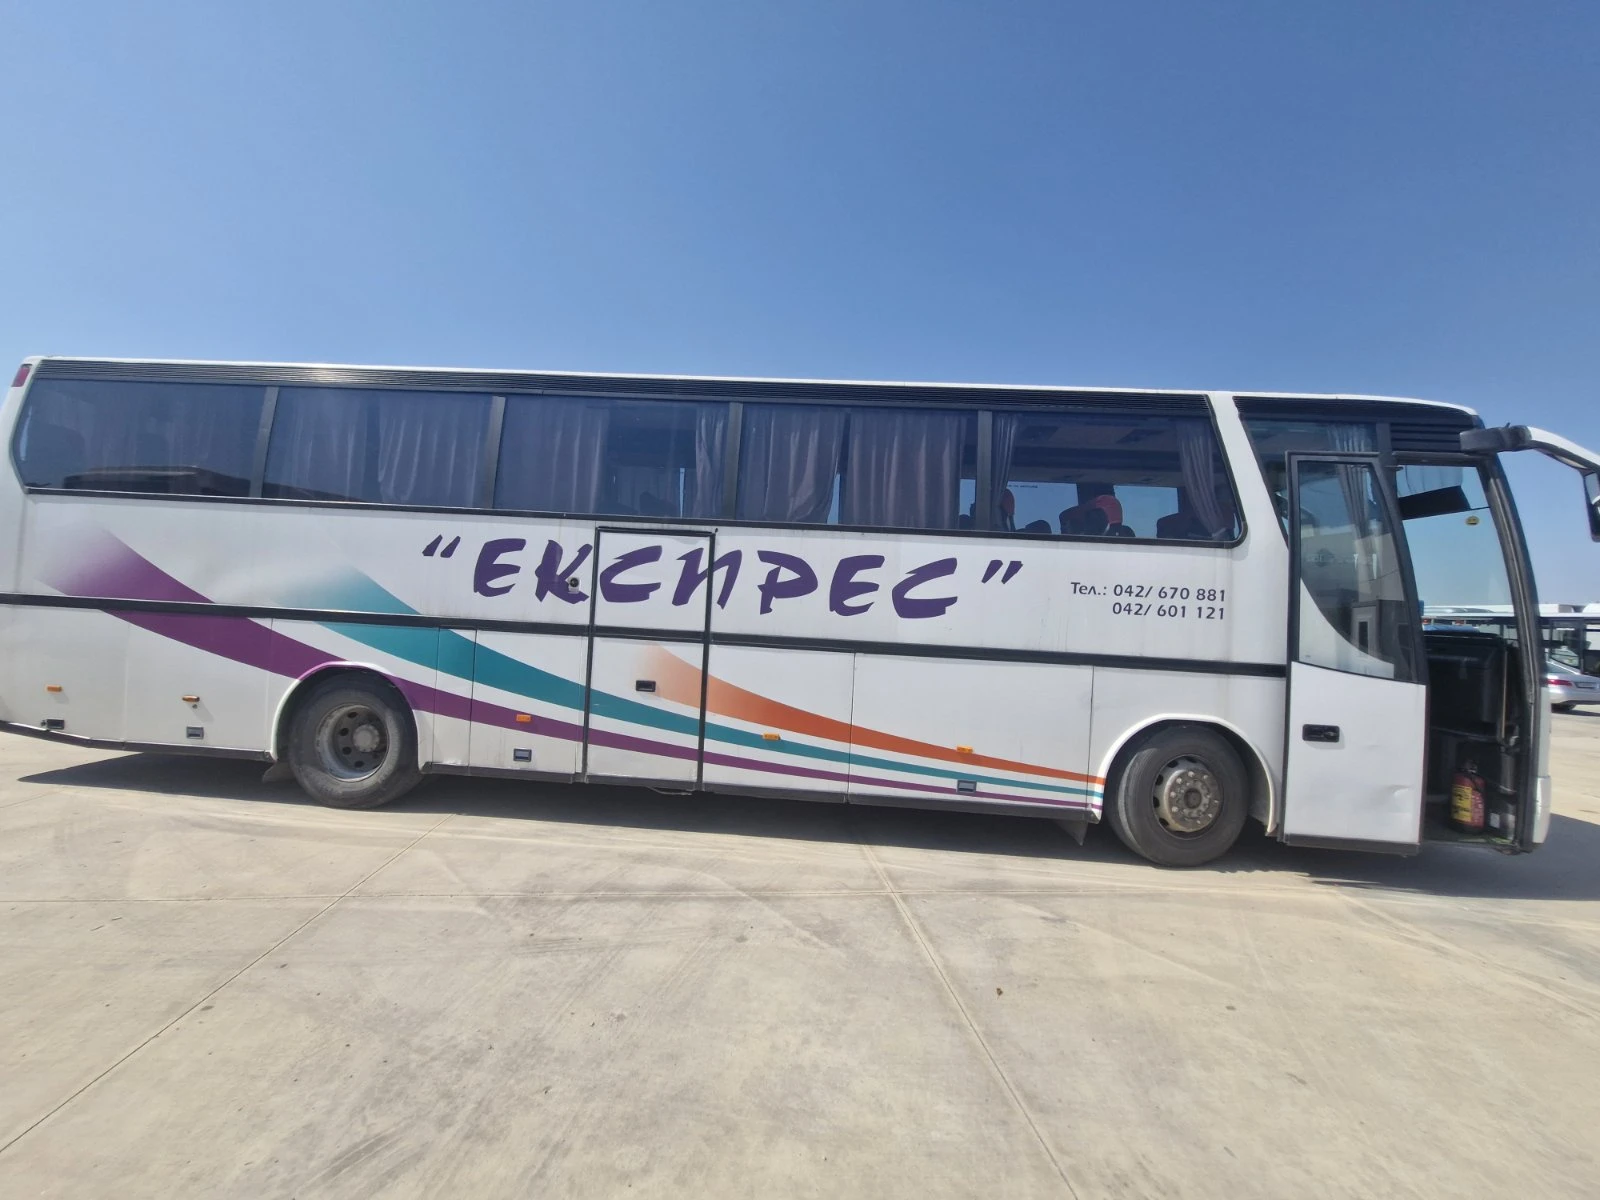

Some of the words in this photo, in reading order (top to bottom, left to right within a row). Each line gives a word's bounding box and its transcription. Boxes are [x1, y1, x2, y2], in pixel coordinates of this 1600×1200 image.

[1071, 582, 1107, 596] Тел.:
[1113, 584, 1153, 598] 042/
[1158, 587, 1190, 600] 670
[1196, 588, 1226, 602] 881
[1112, 602, 1152, 616] 042/
[1157, 604, 1187, 618] 601
[1196, 606, 1225, 620] 121
